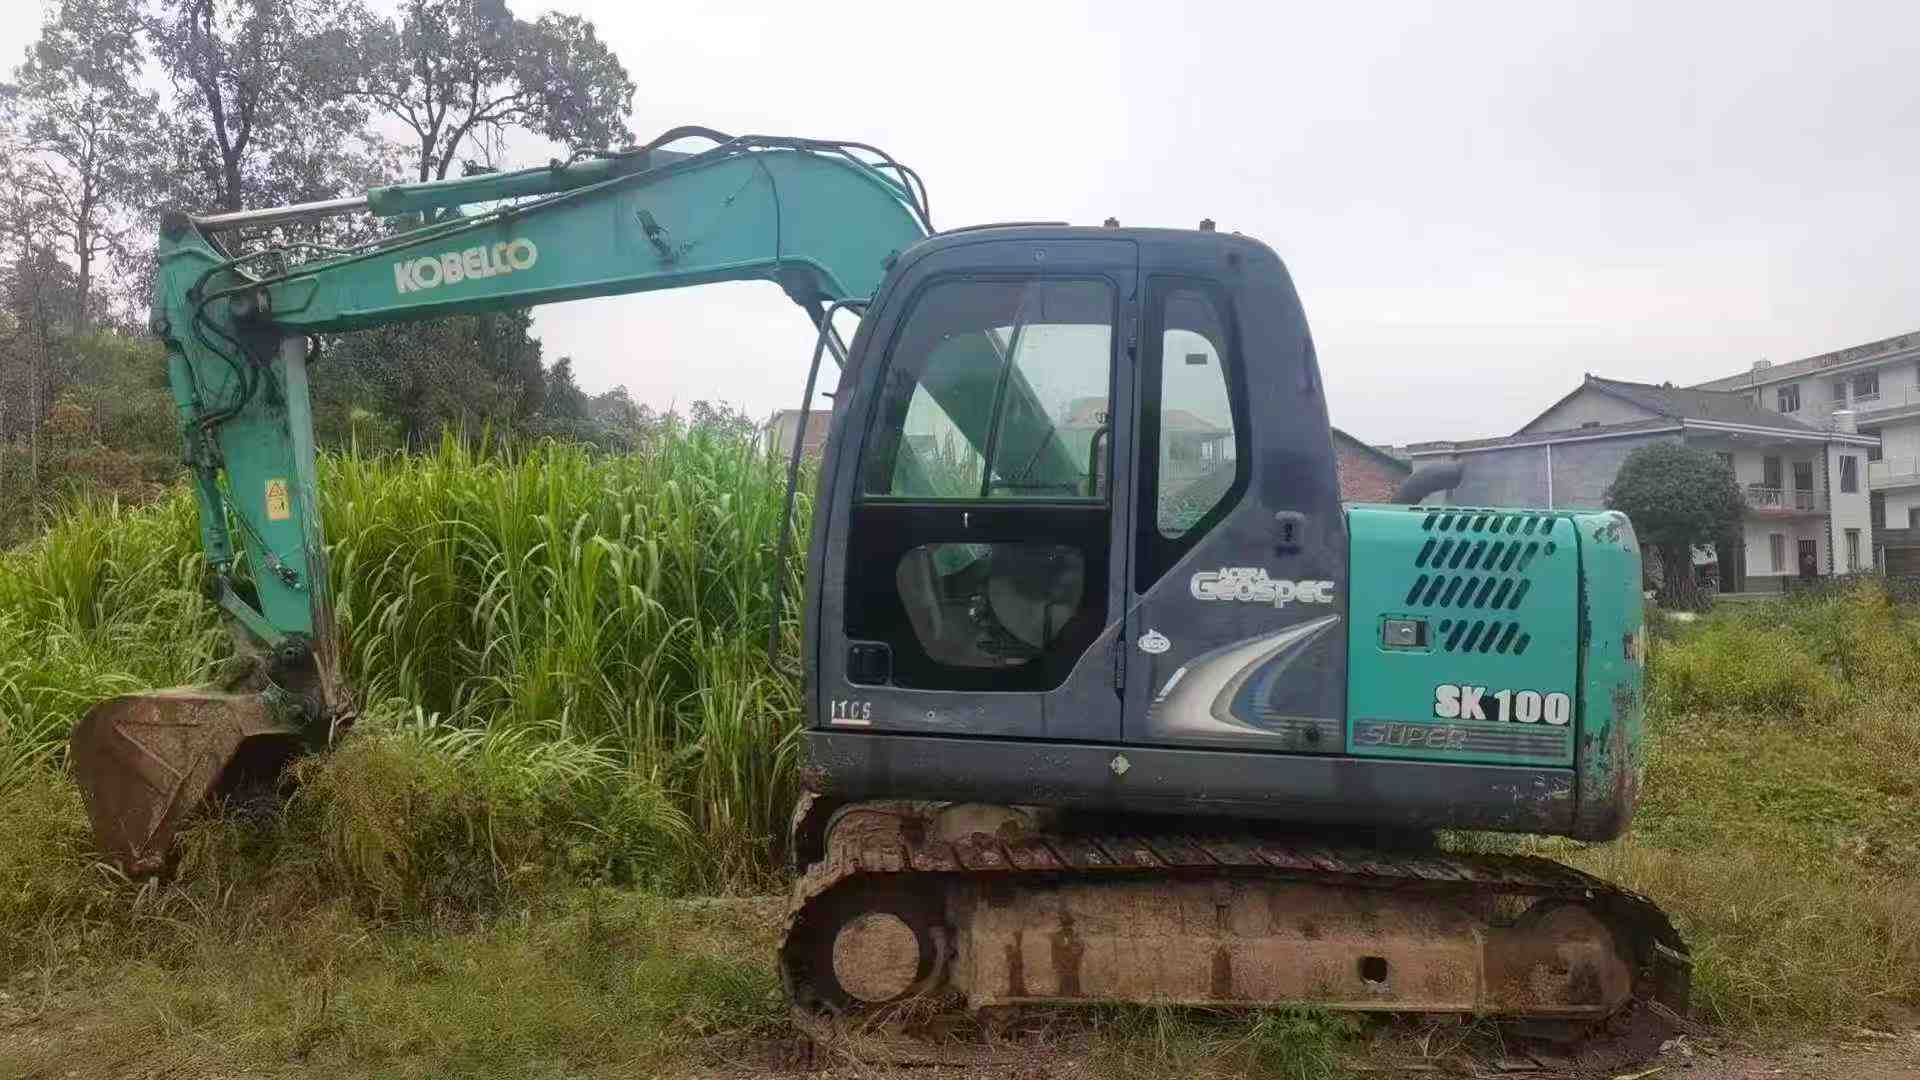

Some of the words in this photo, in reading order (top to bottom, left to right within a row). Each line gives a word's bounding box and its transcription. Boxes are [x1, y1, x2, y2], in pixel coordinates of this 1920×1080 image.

[393, 237, 538, 294] KOBELCO
[1434, 684, 1487, 720] SK
[1493, 689, 1570, 726] 100
